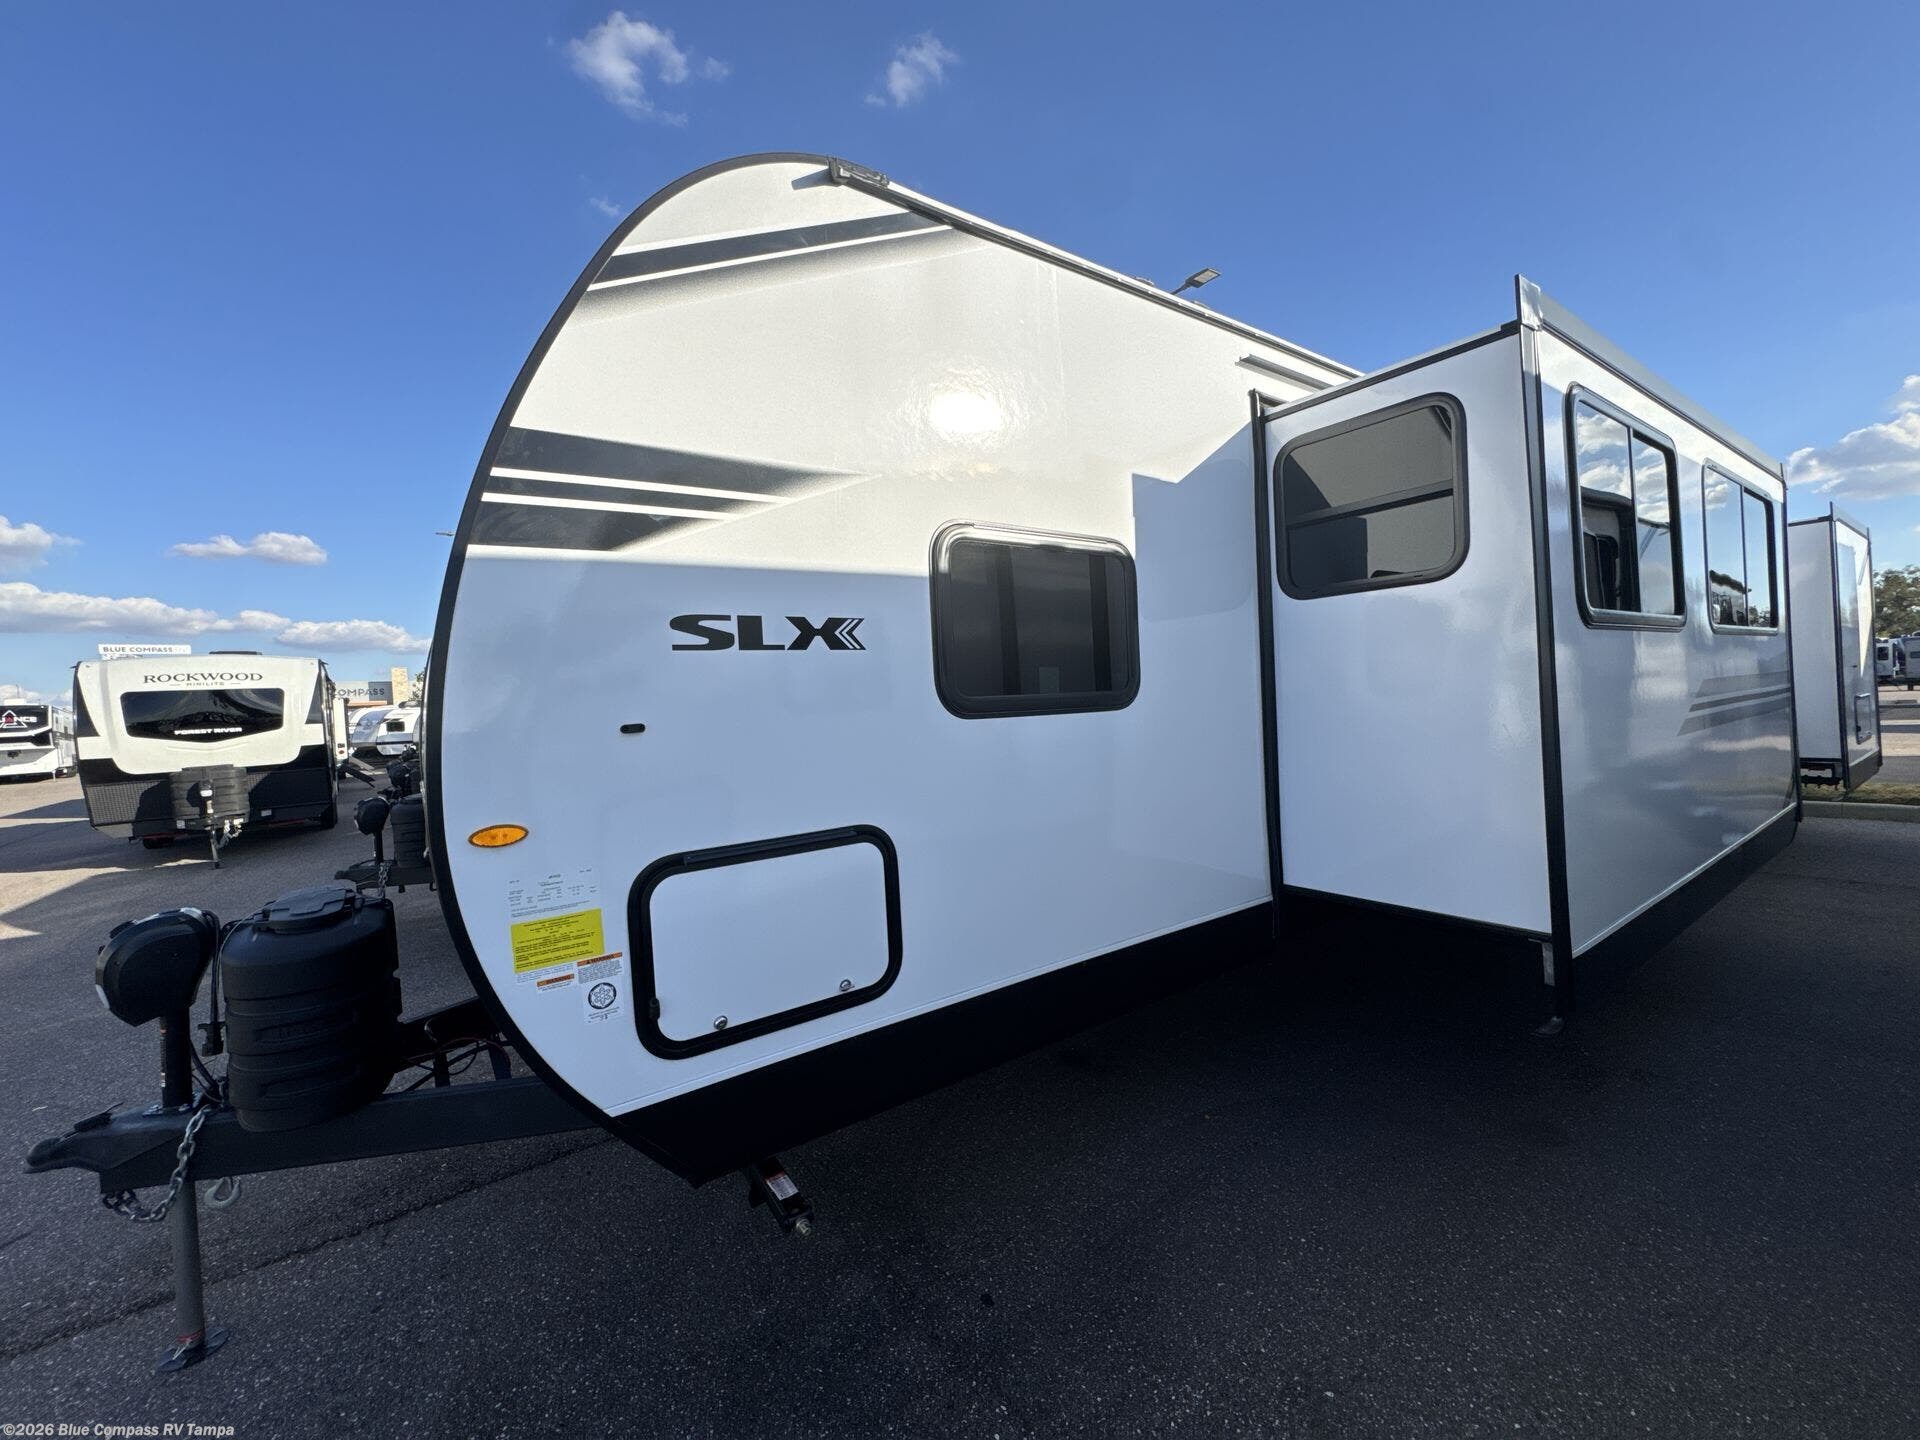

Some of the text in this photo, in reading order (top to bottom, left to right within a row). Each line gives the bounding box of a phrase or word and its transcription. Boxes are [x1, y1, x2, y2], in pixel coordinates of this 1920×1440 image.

[669, 614, 866, 651] SLX
[143, 672, 263, 683] ROCKWOOD
[334, 688, 385, 696] OMPASS
